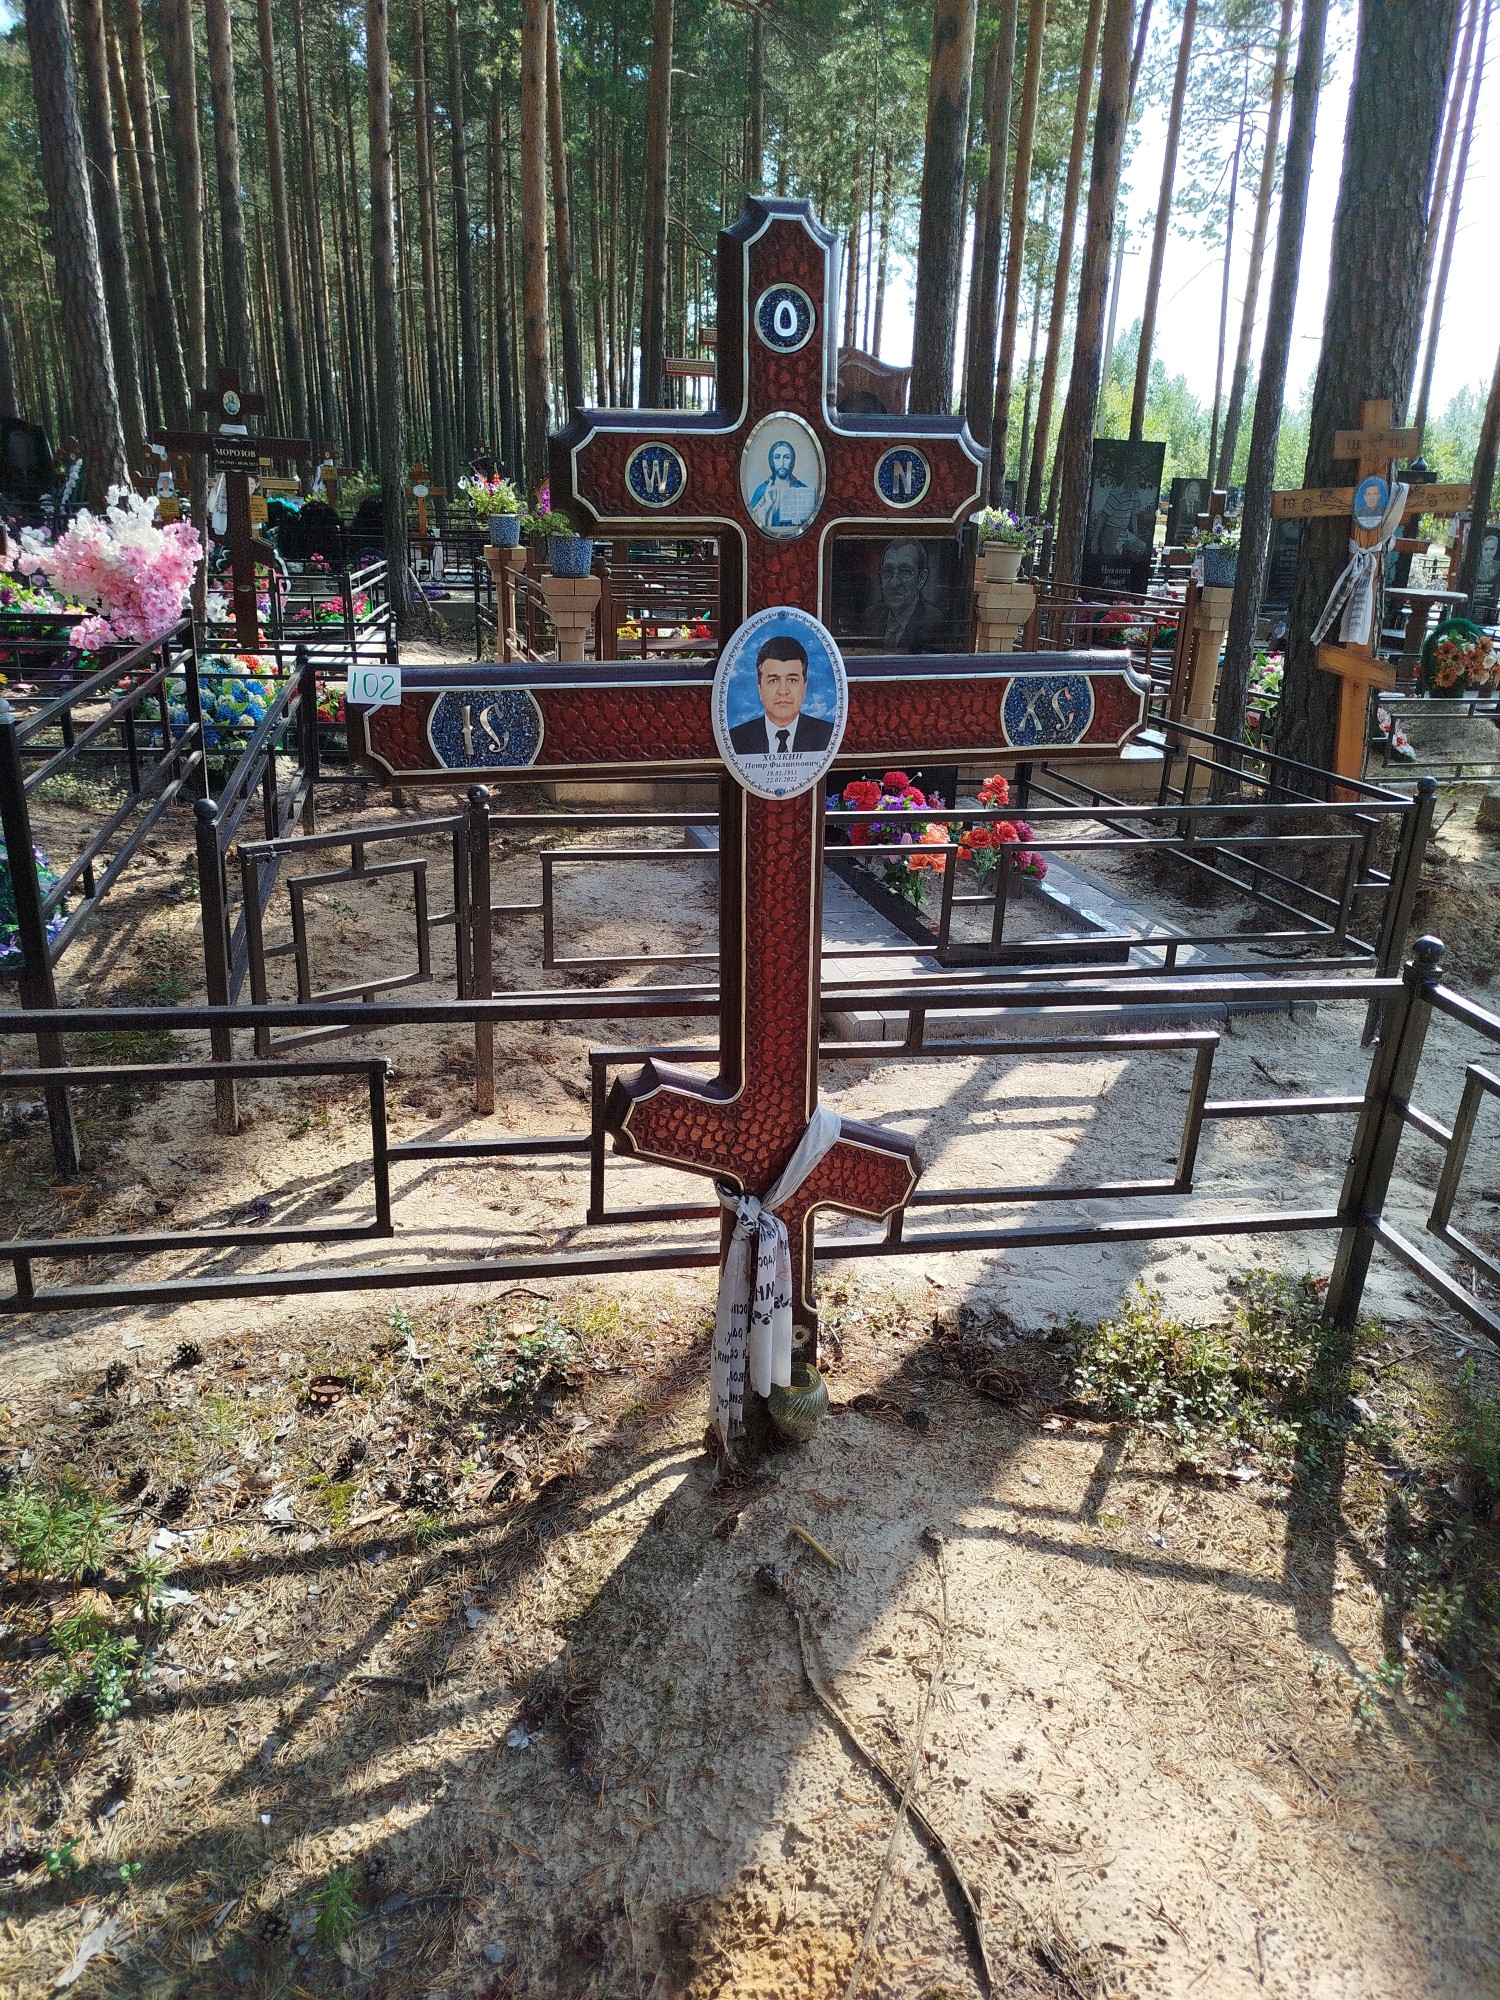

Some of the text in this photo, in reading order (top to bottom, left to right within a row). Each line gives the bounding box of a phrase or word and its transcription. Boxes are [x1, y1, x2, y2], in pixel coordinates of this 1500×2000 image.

[215, 448, 256, 458] МОРОЗОВ
[641, 460, 913, 494] W N
[352, 672, 400, 700] 102
[762, 753, 803, 761] ХОЛКИН
[744, 762, 768, 770] Петр
